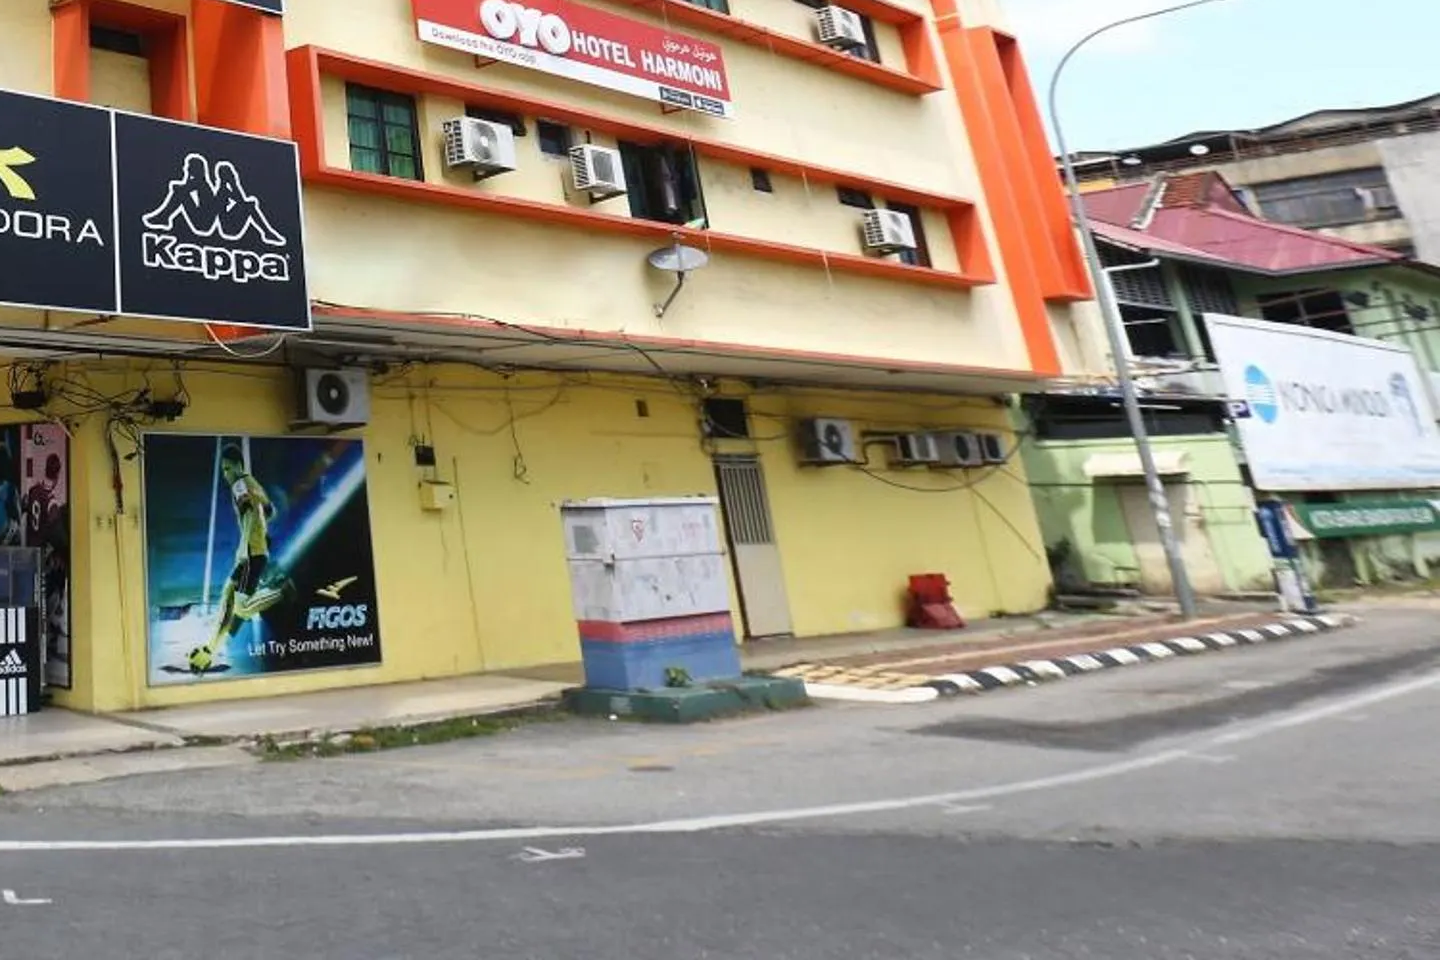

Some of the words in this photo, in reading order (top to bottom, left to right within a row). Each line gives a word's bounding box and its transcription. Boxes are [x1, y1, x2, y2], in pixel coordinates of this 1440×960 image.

[573, 30, 636, 68] HOTEL
[641, 49, 724, 91] HARMONI
[141, 233, 290, 283] Kappa
[247, 641, 266, 657] Let
[268, 640, 287, 657] Try
[289, 636, 346, 654] Something
[346, 633, 375, 647] New!
